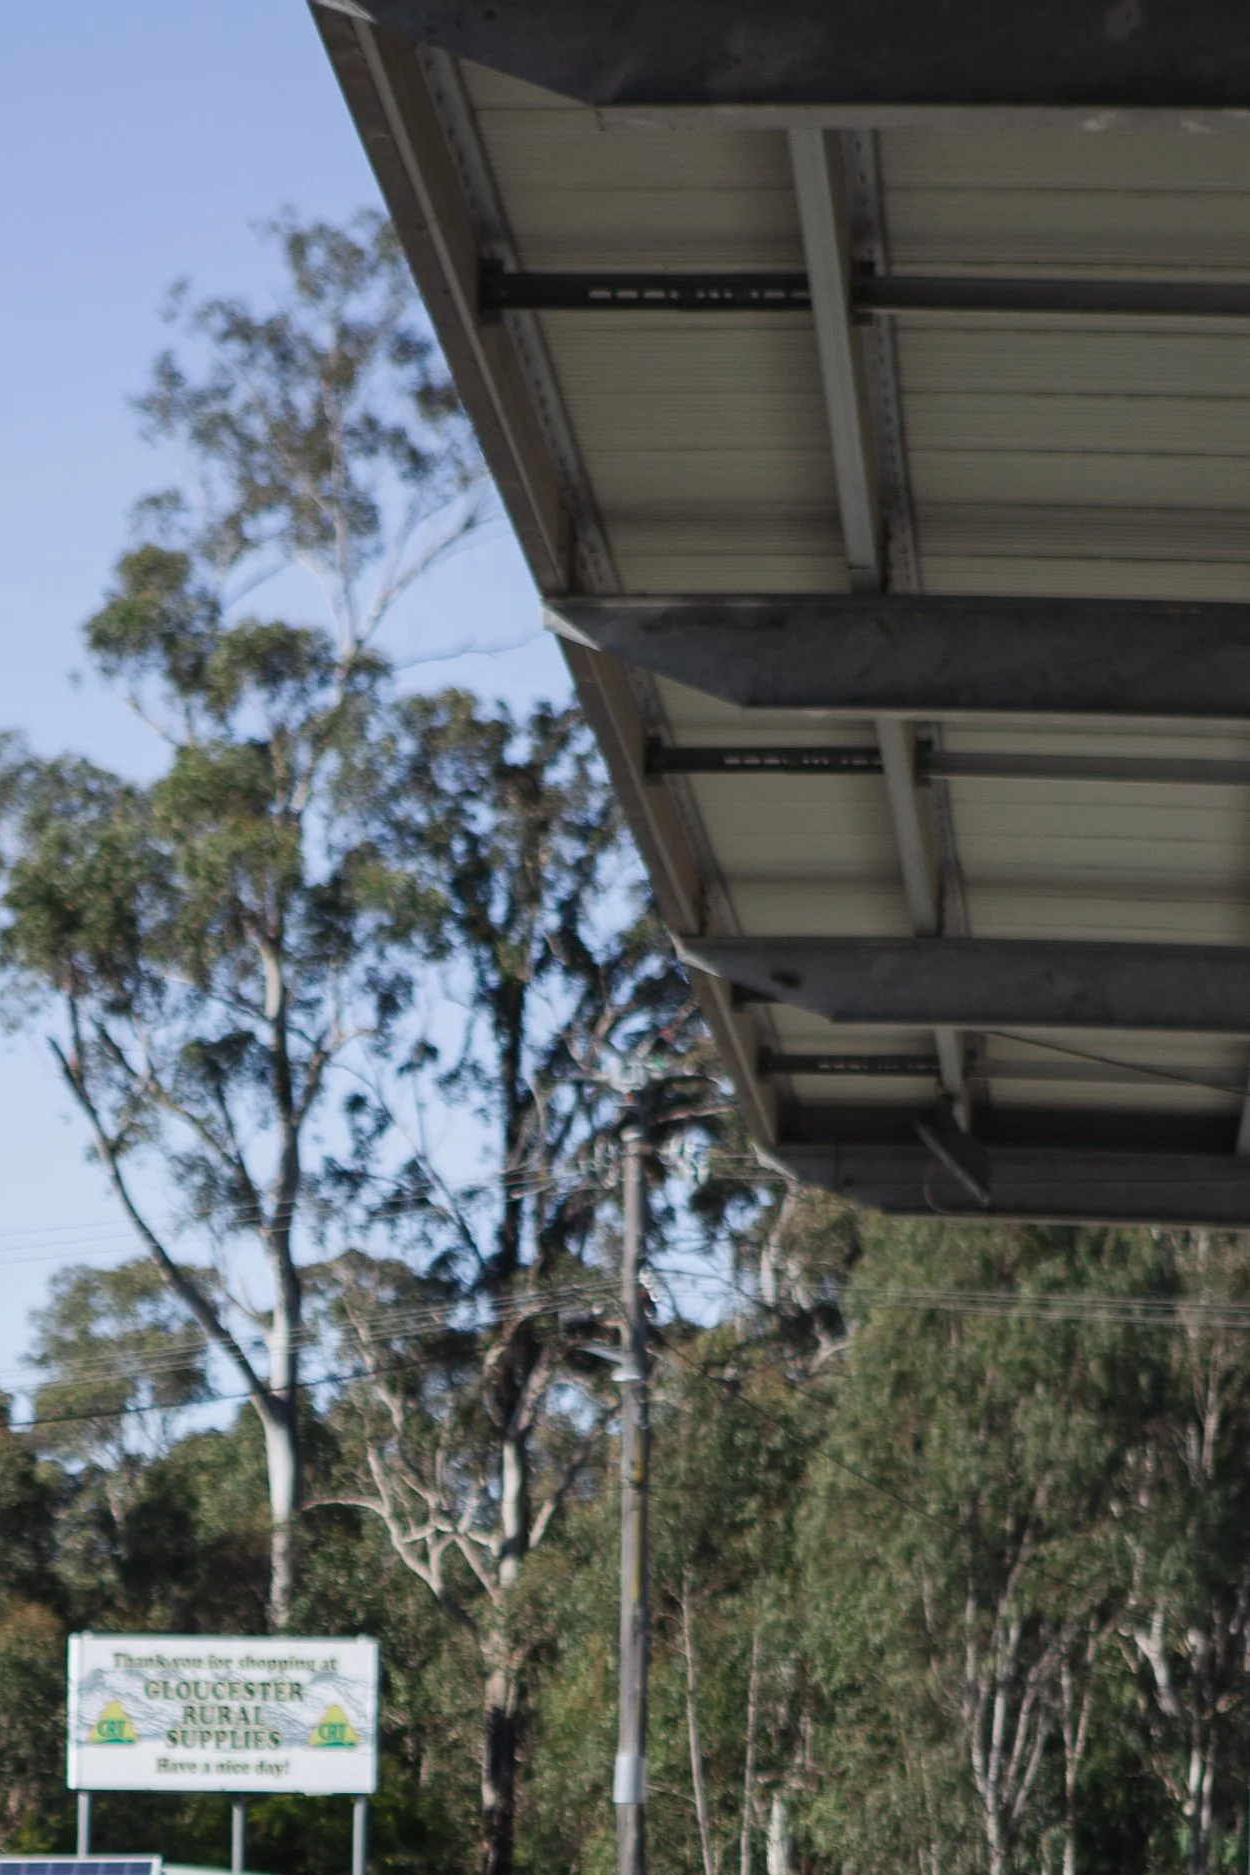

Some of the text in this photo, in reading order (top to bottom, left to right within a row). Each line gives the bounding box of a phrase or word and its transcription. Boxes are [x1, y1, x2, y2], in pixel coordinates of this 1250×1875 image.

[113, 1653, 338, 1672] Thank you for shopping at
[144, 1680, 304, 1701] GLOUCESTER
[182, 1705, 266, 1725] RURAL
[165, 1729, 283, 1750] SUPPLIES
[156, 1758, 197, 1774] Have
[215, 1760, 250, 1774] nice
